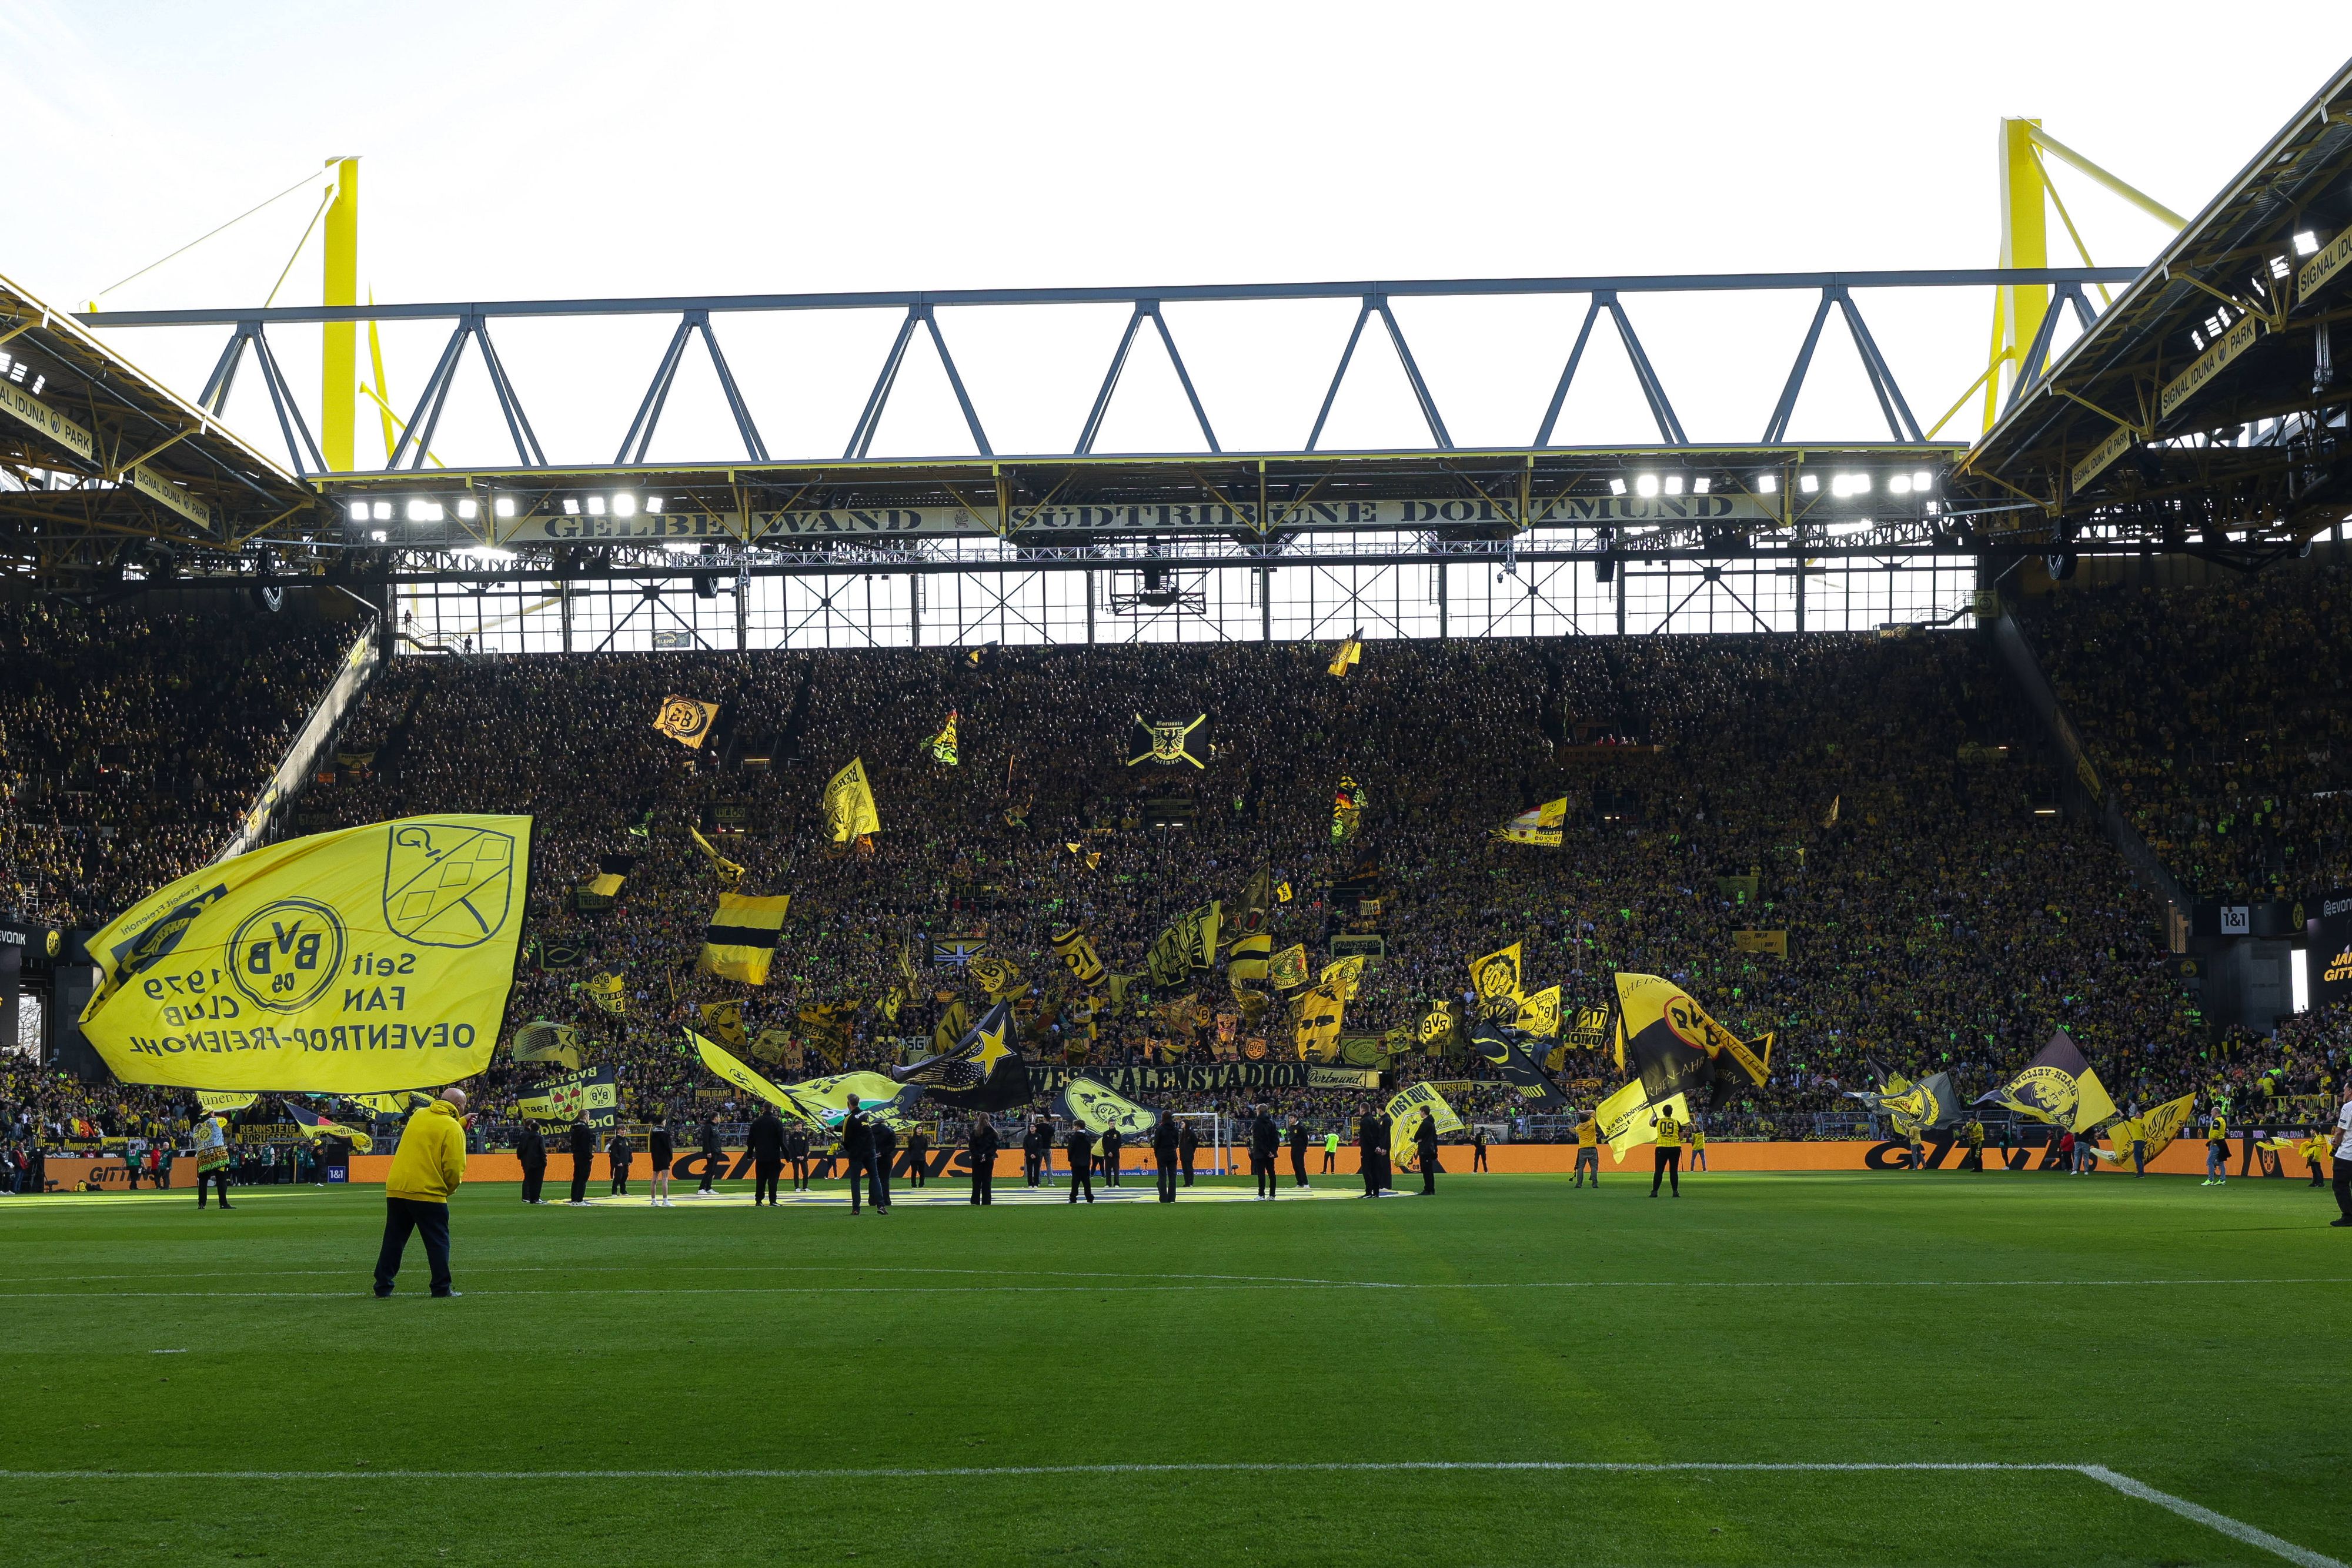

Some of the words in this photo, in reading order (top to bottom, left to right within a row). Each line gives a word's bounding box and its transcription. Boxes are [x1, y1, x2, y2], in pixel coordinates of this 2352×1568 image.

[2301, 251, 2336, 292] SIGNAL
[2163, 376, 2190, 410] SIGNAL
[2191, 354, 2215, 386] IDUNA
[2231, 320, 2253, 352] PARK
[15, 394, 45, 426] IDUNA
[65, 424, 90, 452] PARK
[2074, 463, 2090, 484] SIGNAL
[2091, 450, 2105, 471] IDUNA
[2114, 430, 2127, 450] PARK
[138, 470, 161, 493] SIGNAL
[162, 484, 181, 505] IDUNA
[192, 503, 208, 521] PARK
[544, 513, 726, 538] GELBE
[758, 508, 922, 534] WAND
[1010, 501, 1378, 528] SÜDTRIBÜNE
[1399, 496, 1734, 522] DORTMUND
[2223, 913, 2246, 927] 1&1
[906, 1037, 924, 1051] SG
[1250, 1042, 1262, 1052] BVB
[1028, 1062, 1310, 1092] WESFALENSTADION
[1308, 1069, 1363, 1085] Dortmund
[696, 1089, 732, 1097] HOOLIGANS
[239, 1124, 296, 1133] RENNSTEIG
[1660, 1122, 1674, 1135] 09
[330, 1169, 343, 1179] 1&1
